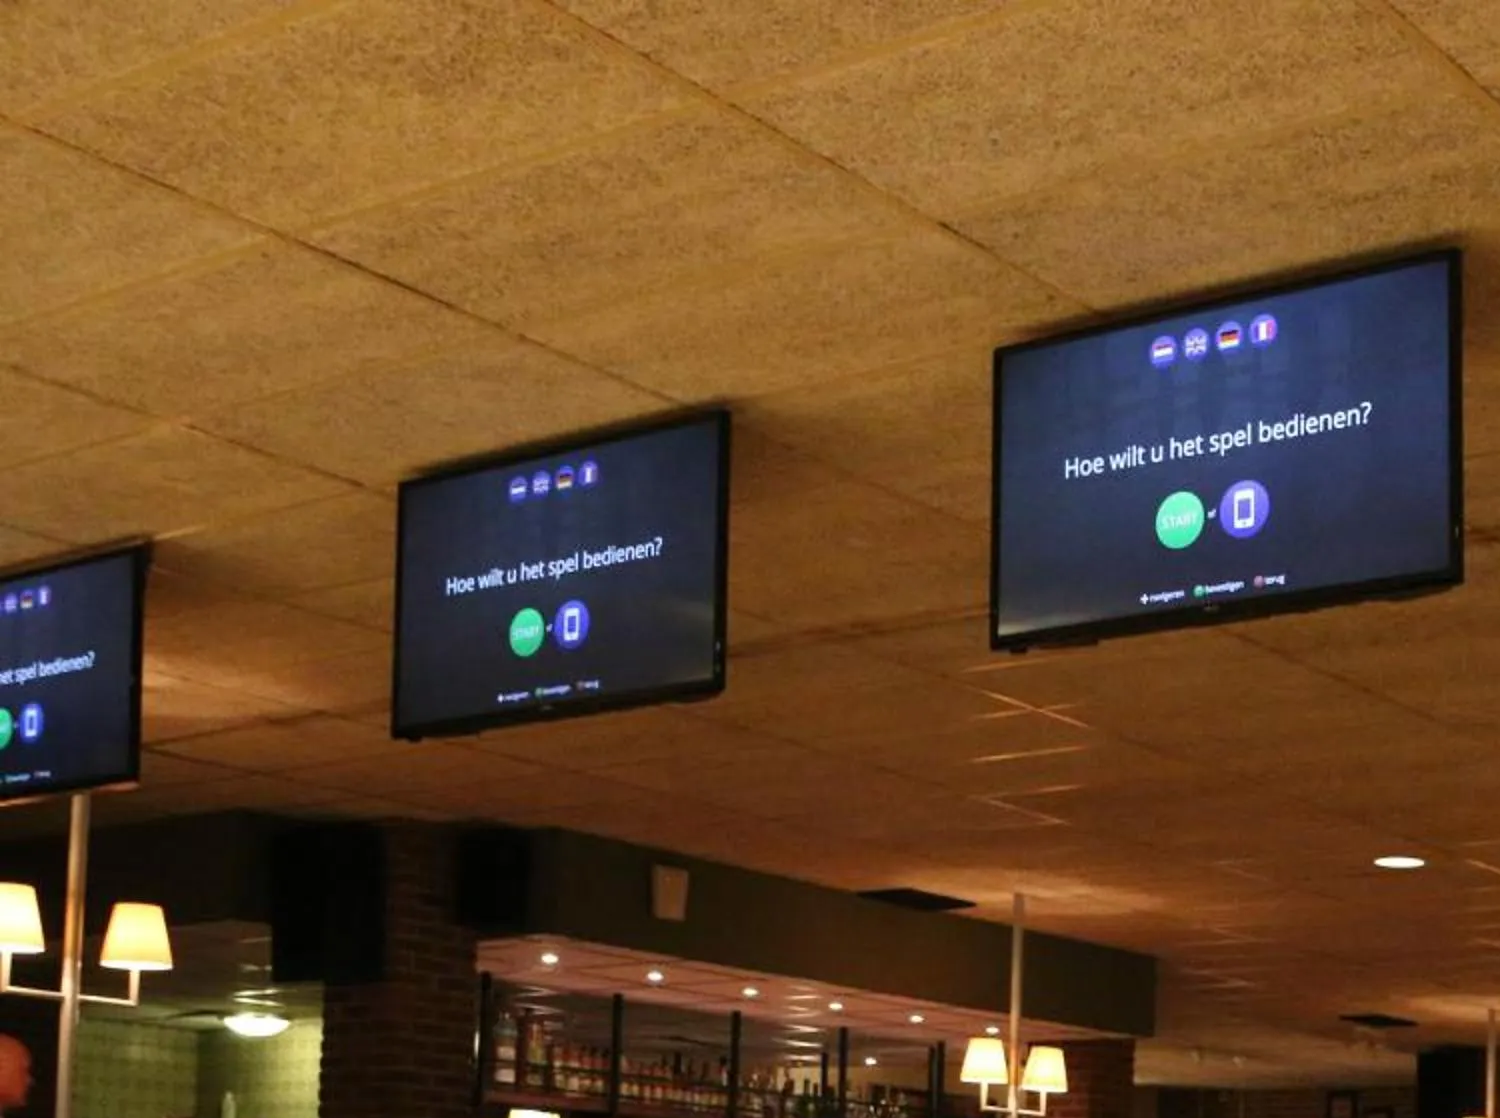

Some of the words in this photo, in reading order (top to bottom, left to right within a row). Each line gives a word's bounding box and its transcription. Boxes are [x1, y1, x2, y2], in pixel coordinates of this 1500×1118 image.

[1064, 456, 1105, 479] Hoe
[1109, 444, 1145, 471] wilt
[1151, 444, 1163, 462] u
[1169, 435, 1204, 460] het
[1209, 423, 1252, 457] spel
[1258, 401, 1373, 443] bedienen?
[446, 576, 475, 596] Hoe
[478, 568, 503, 590] wilt
[507, 569, 517, 584] u
[520, 562, 545, 581] het
[548, 553, 579, 580] spel
[583, 536, 663, 569] bedienen?
